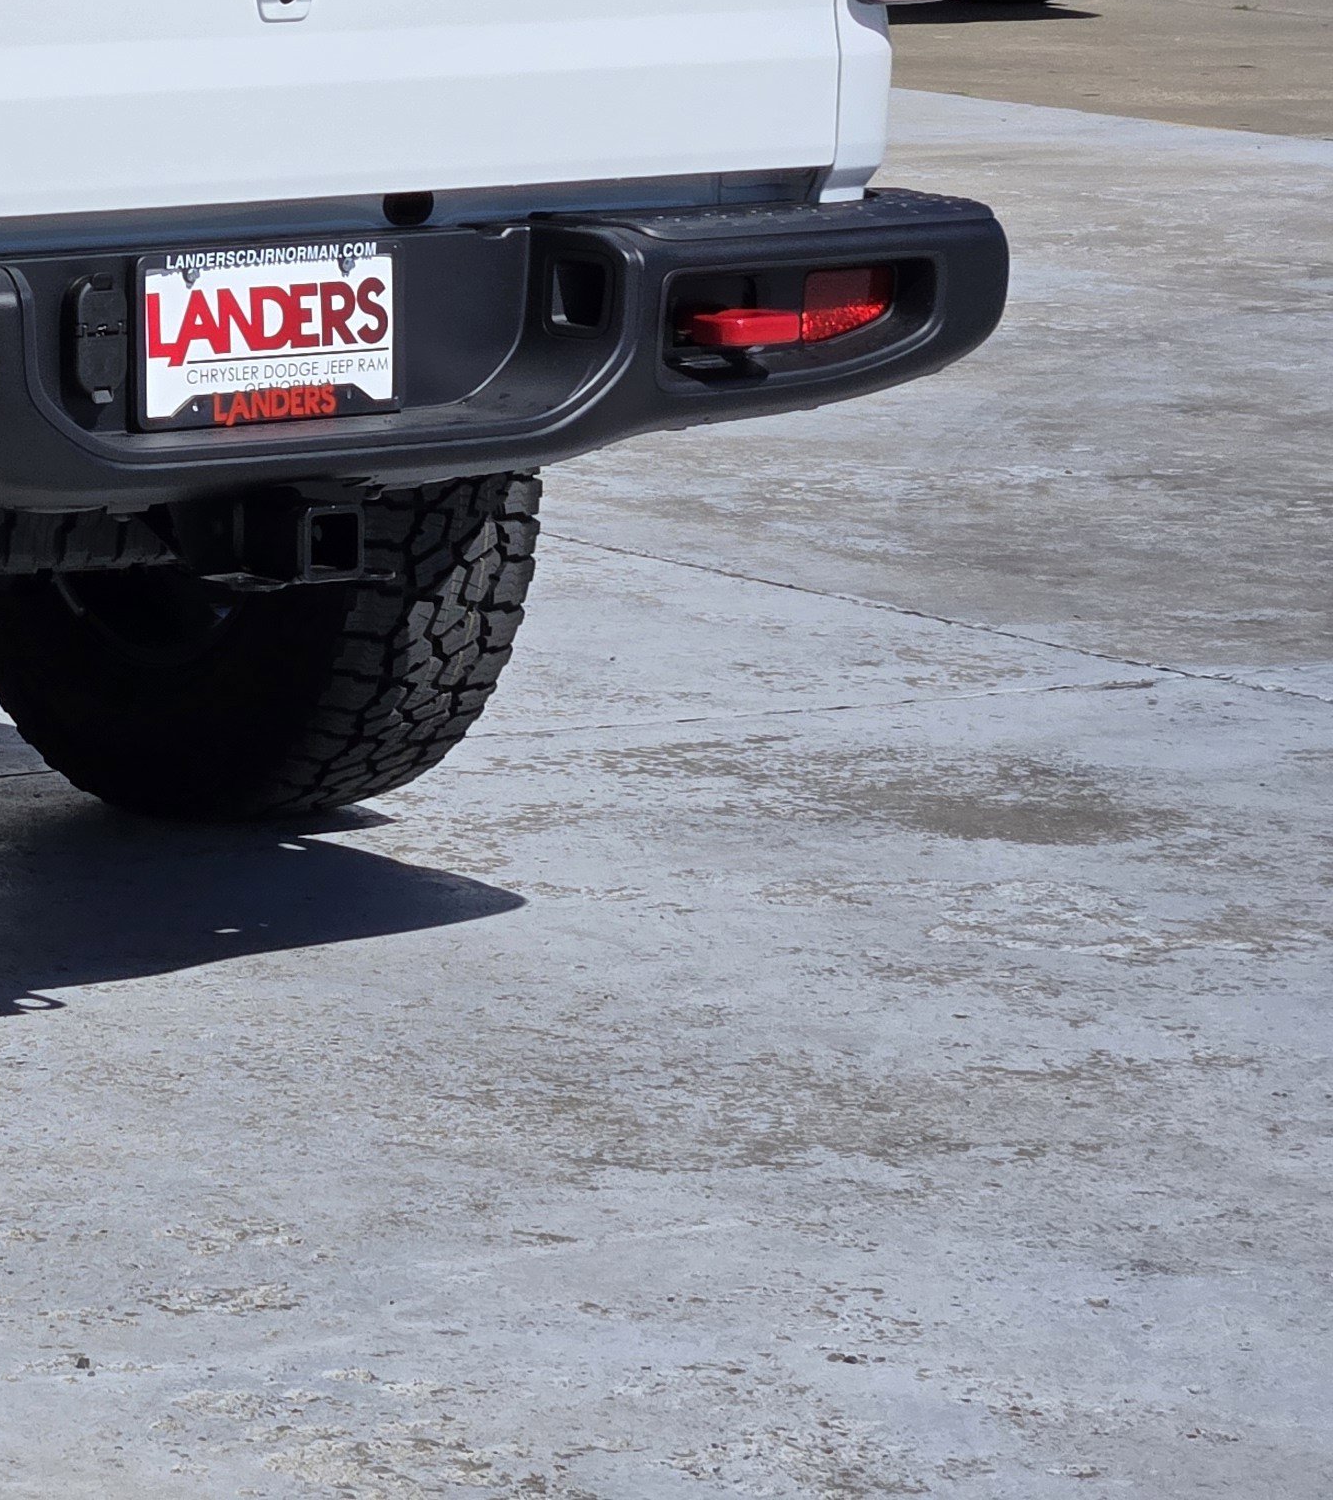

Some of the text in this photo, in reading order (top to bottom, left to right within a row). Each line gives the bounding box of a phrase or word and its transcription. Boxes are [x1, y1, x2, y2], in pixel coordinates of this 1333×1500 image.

[166, 242, 377, 270] LANDERSCDJRNORMAN.COM
[147, 276, 389, 367] LANDERS
[186, 357, 389, 384] CHRYSLER DODGE JEEP RAM
[212, 384, 337, 426] LANDERS
